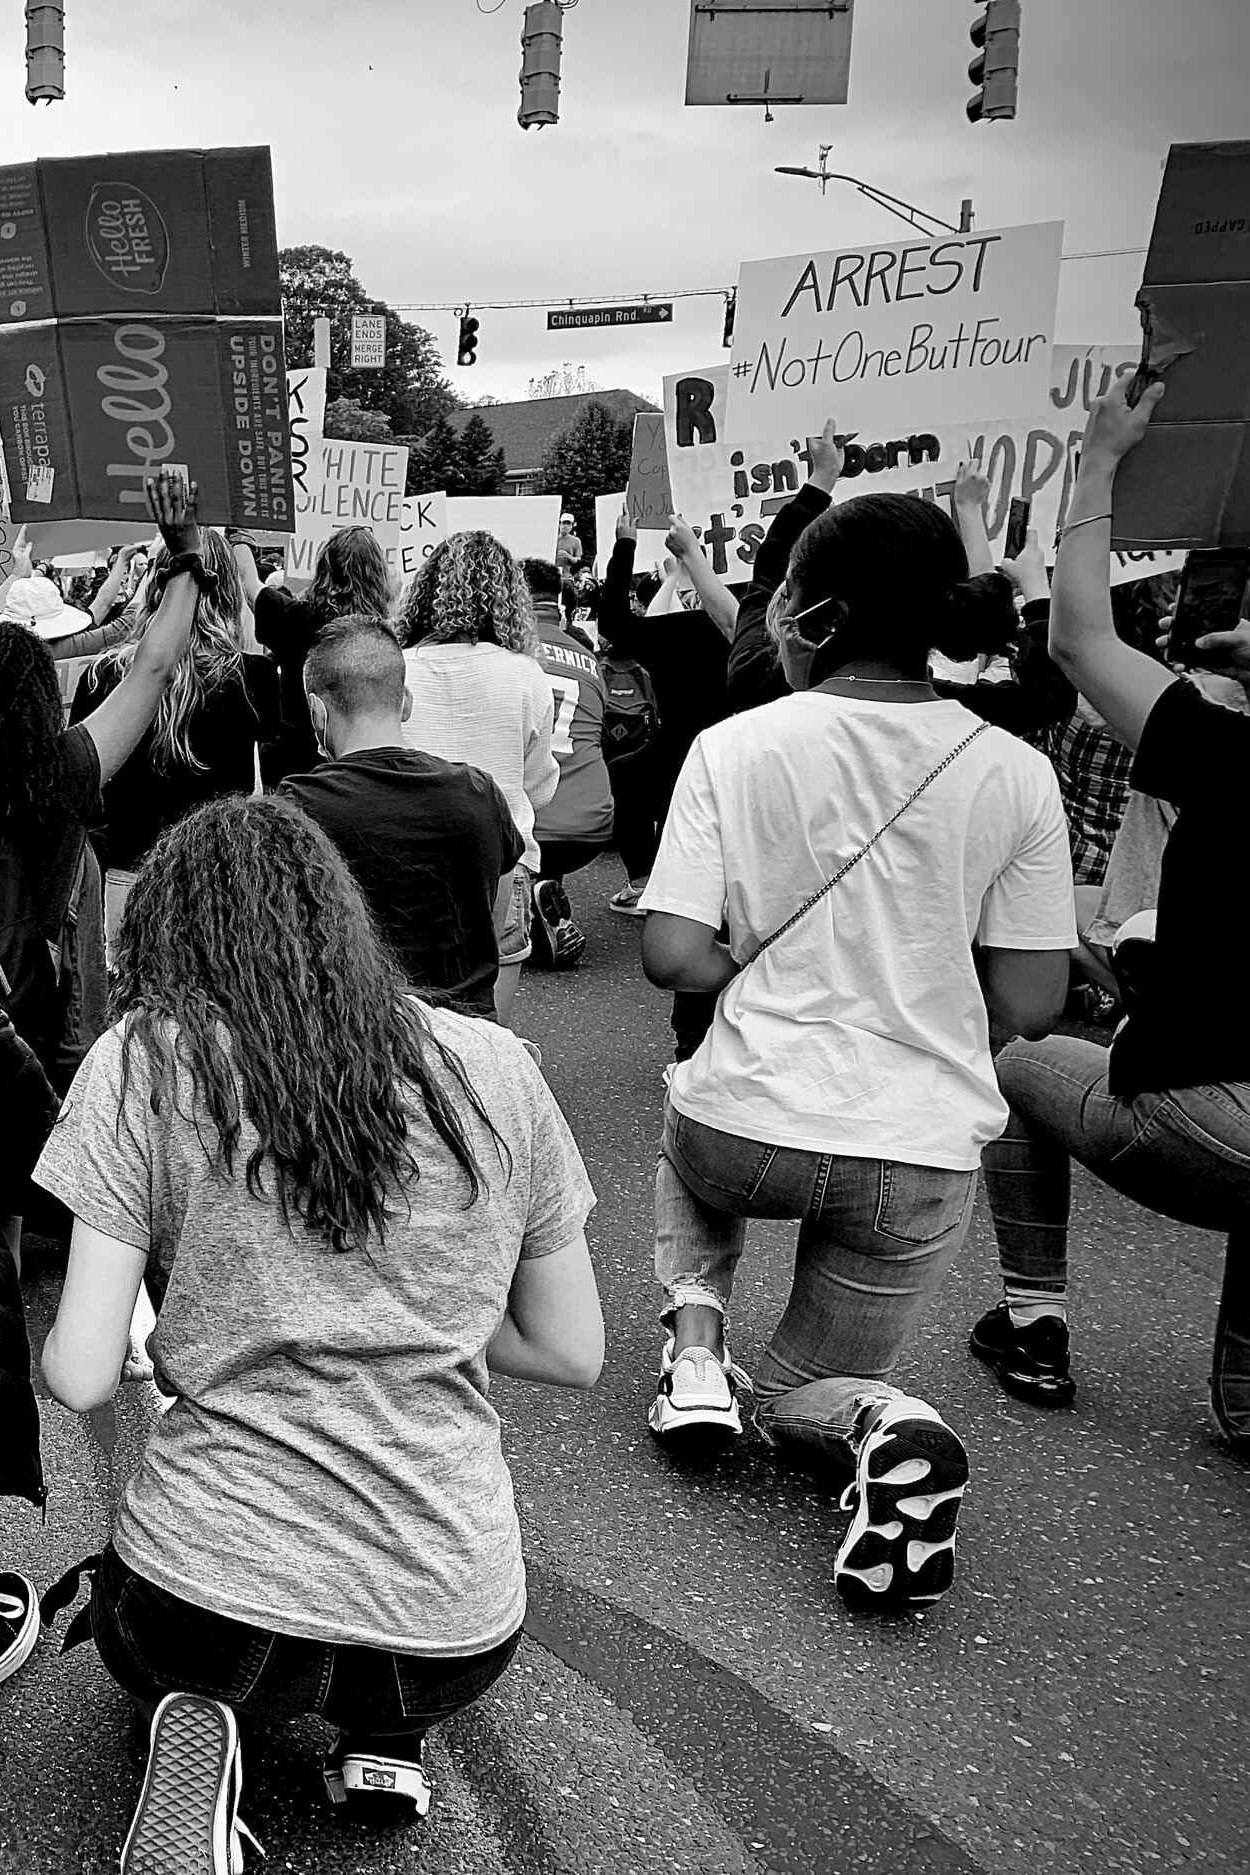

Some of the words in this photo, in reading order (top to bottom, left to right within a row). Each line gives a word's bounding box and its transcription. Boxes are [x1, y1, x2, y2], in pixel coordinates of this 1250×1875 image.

[122, 199, 155, 264] FRESH
[235, 199, 247, 232] MEDIUM
[99, 199, 141, 277] Hello
[239, 233, 251, 268] WINTER
[781, 235, 1002, 318] ARREST
[355, 320, 383, 329] LANE
[355, 330, 383, 339] ENDS
[551, 311, 610, 327] Chinquapin
[355, 344, 383, 353] MERGE
[355, 354, 383, 363] RIGHT
[733, 317, 1047, 393] #NotOneButFour
[229, 334, 250, 429] UPSIDE
[259, 334, 281, 421] DON'T
[10, 405, 19, 422] YOU
[29, 401, 52, 467] terrapa
[12, 423, 22, 456] CARBON
[237, 440, 257, 517] DOWN
[267, 430, 288, 522] PANIC!
[323, 446, 399, 487] HITE
